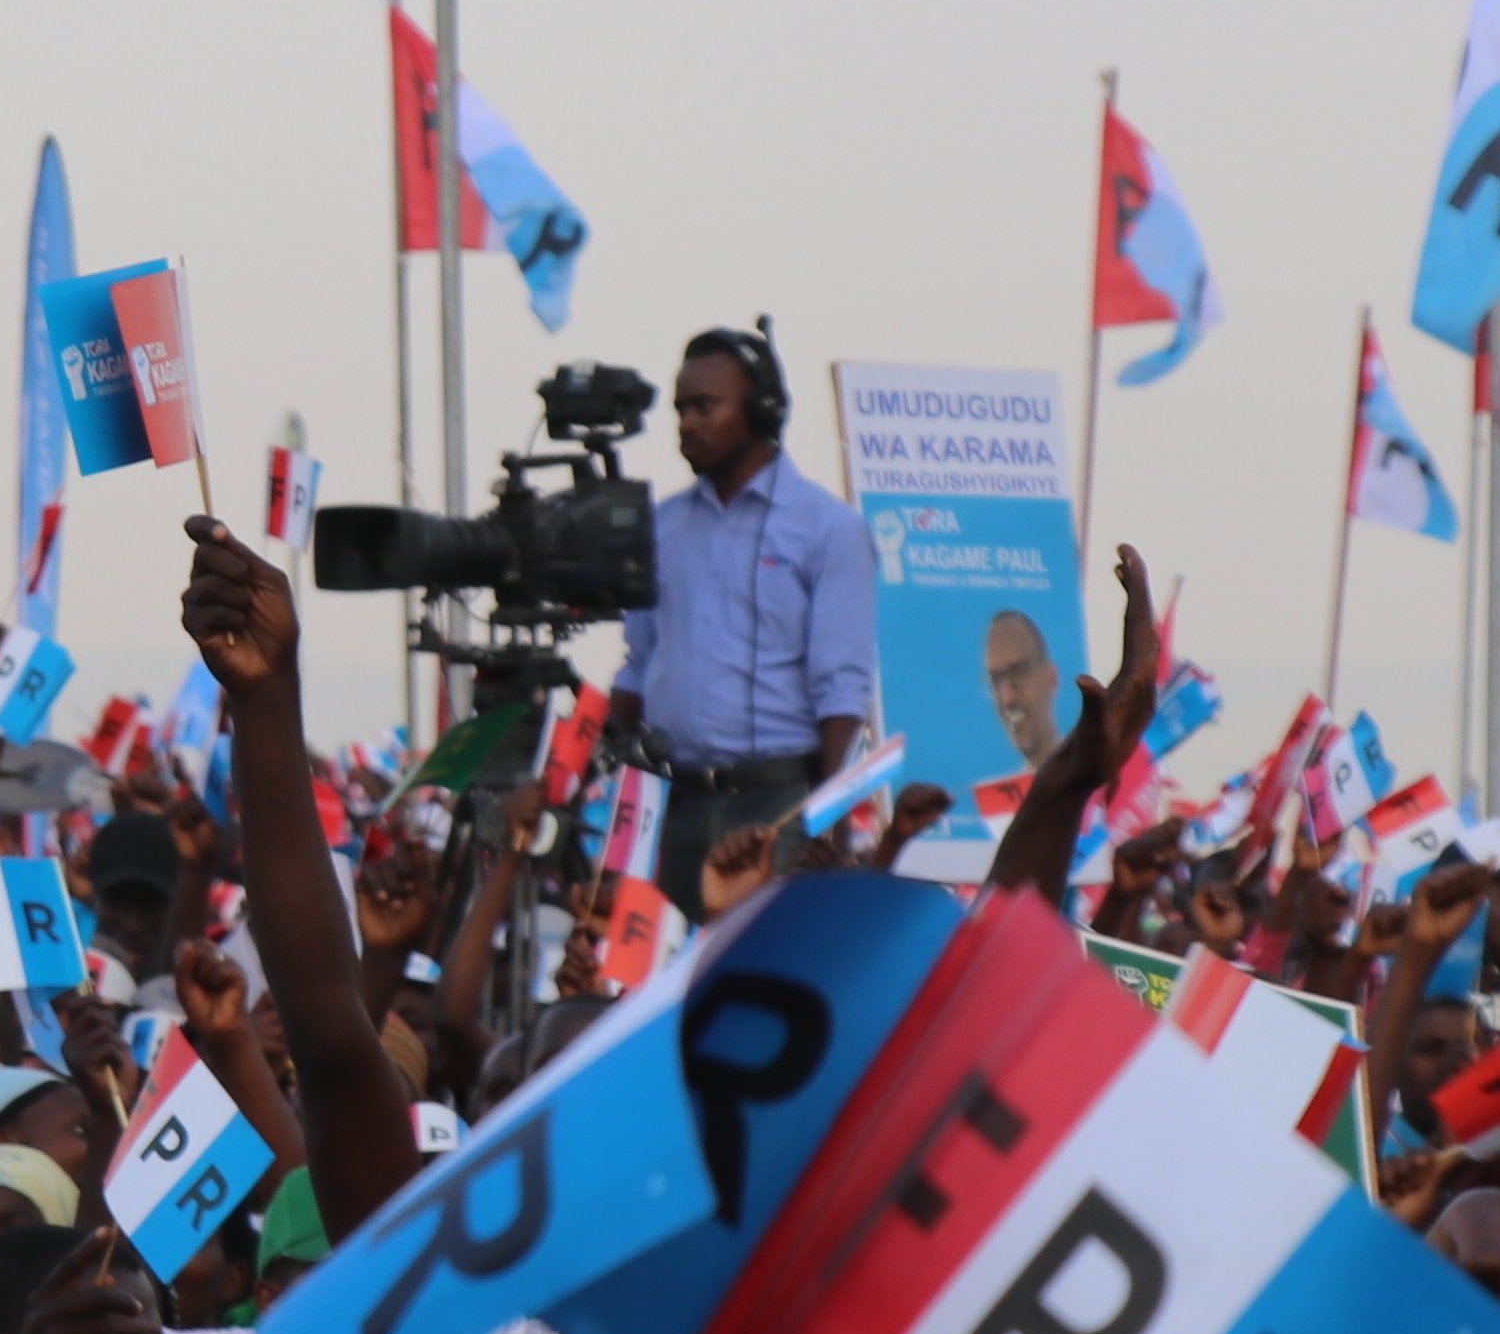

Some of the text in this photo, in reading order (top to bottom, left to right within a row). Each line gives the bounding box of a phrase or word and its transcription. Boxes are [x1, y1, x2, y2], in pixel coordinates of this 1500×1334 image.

[855, 388, 1051, 424] UMUDUGUDU
[859, 432, 1056, 466] WA KARAMA
[907, 545, 1048, 574] KAGAME PAUL
